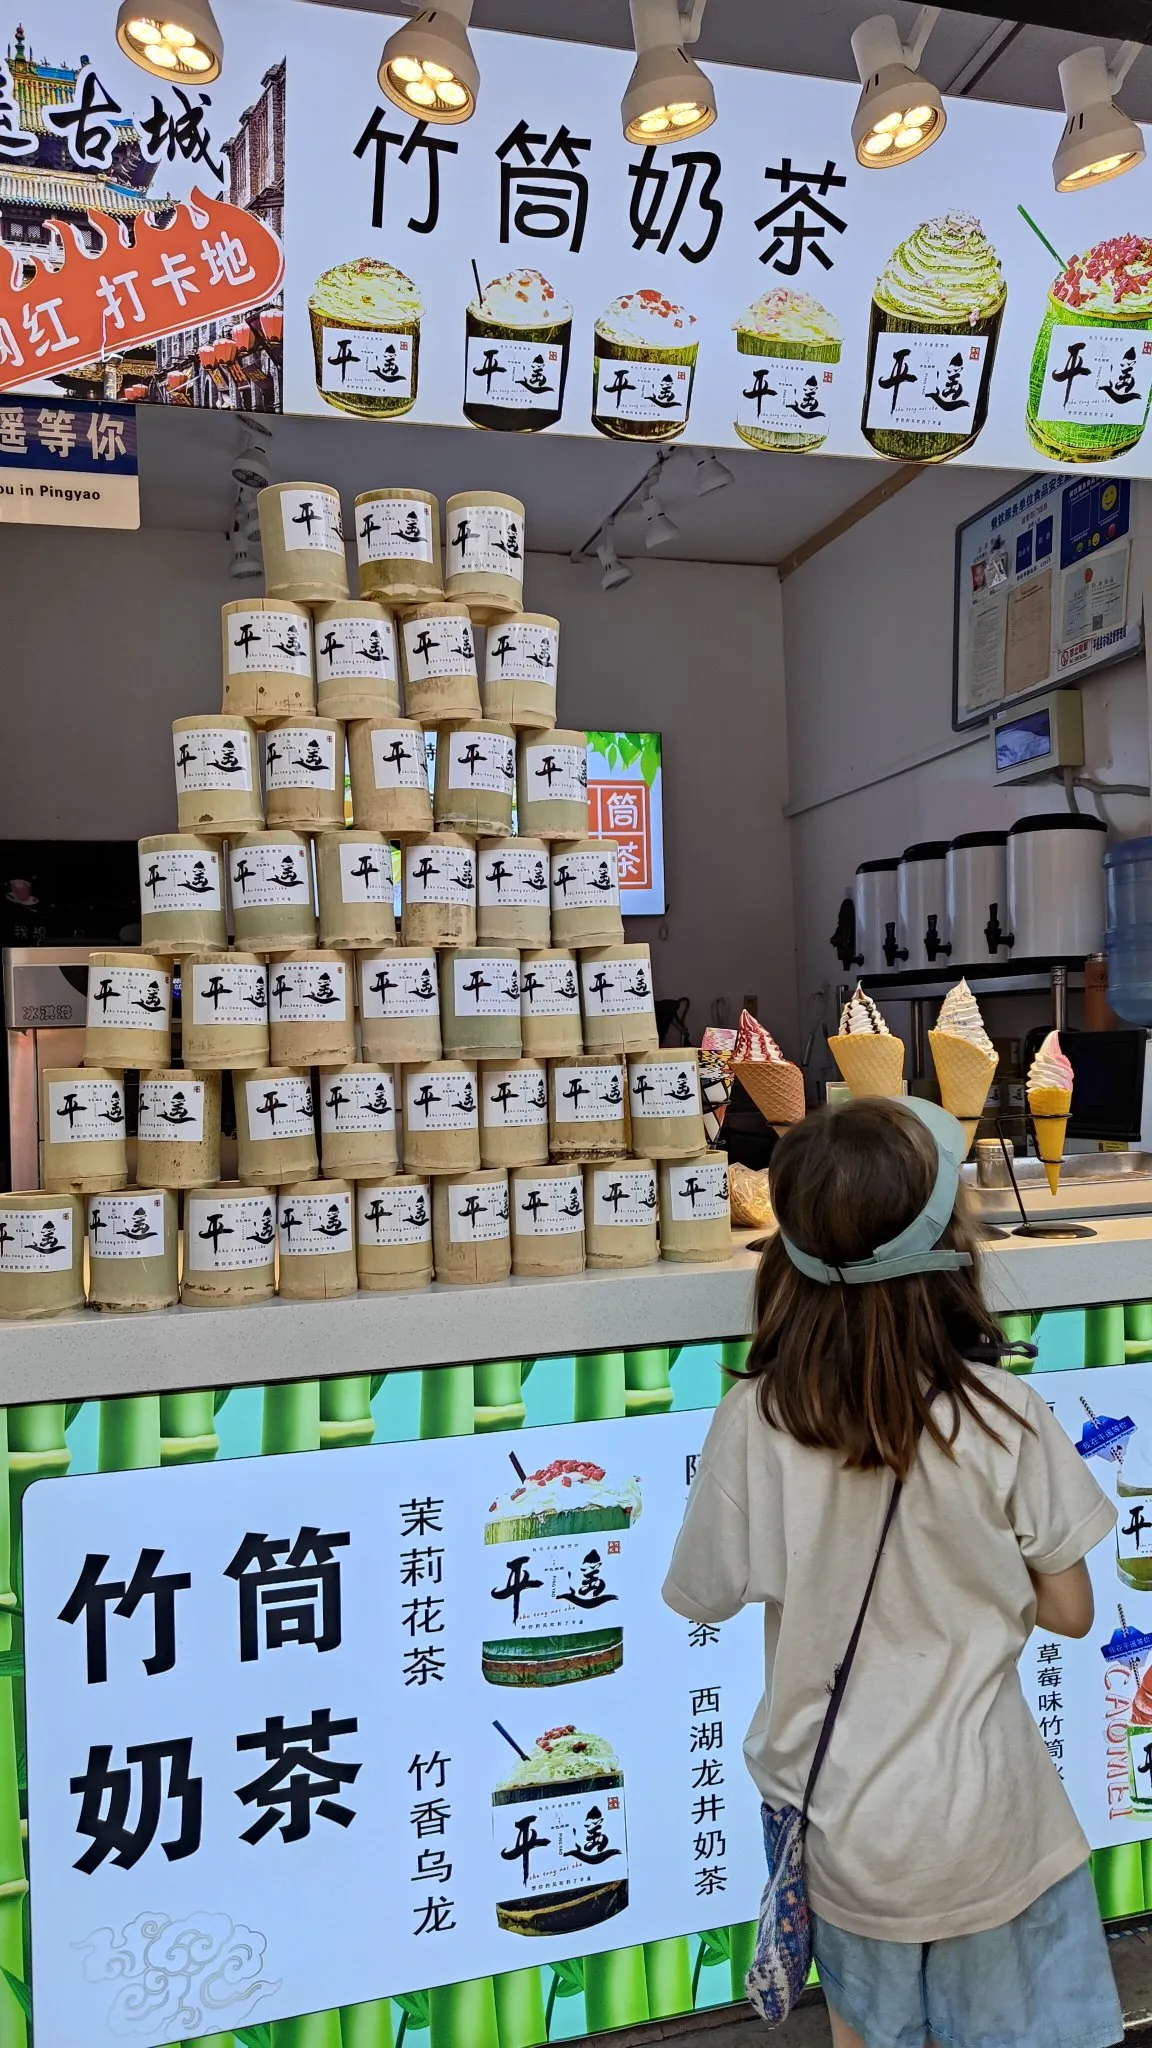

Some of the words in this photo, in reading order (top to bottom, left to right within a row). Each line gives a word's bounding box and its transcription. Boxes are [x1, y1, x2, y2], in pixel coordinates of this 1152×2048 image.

[352, 106, 848, 276] 竹筒奶茶
[95, 231, 256, 330] 打卡地
[328, 340, 406, 383] 平遥
[472, 350, 554, 395] 平遥
[1052, 342, 1142, 410] 平遥
[603, 370, 682, 409] 平遥
[743, 369, 826, 420] 平遥
[878, 349, 970, 418] 平遥
[0, 407, 127, 461] 遥等你
[20, 484, 33, 496] in
[40, 485, 101, 501] Pingyao
[360, 511, 428, 548] 平遥
[452, 520, 522, 559] 平遥
[234, 624, 306, 662] 平遥
[320, 629, 389, 666] 平遥
[492, 636, 554, 669] 平遥
[176, 740, 246, 783] 平遥
[267, 740, 330, 778] 平遥
[382, 742, 428, 775] 平
[606, 792, 638, 829] 筒
[144, 860, 215, 897] 平遥
[234, 856, 304, 894] 平遥
[352, 856, 394, 887] 平
[486, 860, 548, 891] 平遥
[554, 861, 616, 896] 平遥
[94, 979, 166, 1014] 平遥
[272, 972, 341, 1009] 平遥
[370, 968, 436, 1004] 平遥
[521, 970, 578, 1004] 平遥
[590, 969, 650, 1003] 平遥
[326, 1082, 392, 1120] 平遥
[413, 1082, 476, 1117] 平遥
[633, 1072, 696, 1106] 平遥
[56, 1091, 124, 1128] 平遥
[89, 1207, 160, 1245] 平遥
[199, 1206, 276, 1255] 平遥
[280, 1203, 348, 1243] 平遥
[365, 1192, 429, 1233] 平遥
[57, 1526, 351, 1685] 竹筒
[399, 1496, 446, 1686] 茉莉花茶
[491, 1549, 619, 1627] 平遥
[69, 1707, 364, 1875] 奶茶
[688, 1685, 728, 1897] 西湖龙井奶茶
[407, 1750, 457, 1937] 竹香乌龙
[500, 1805, 623, 1888] 平遥
